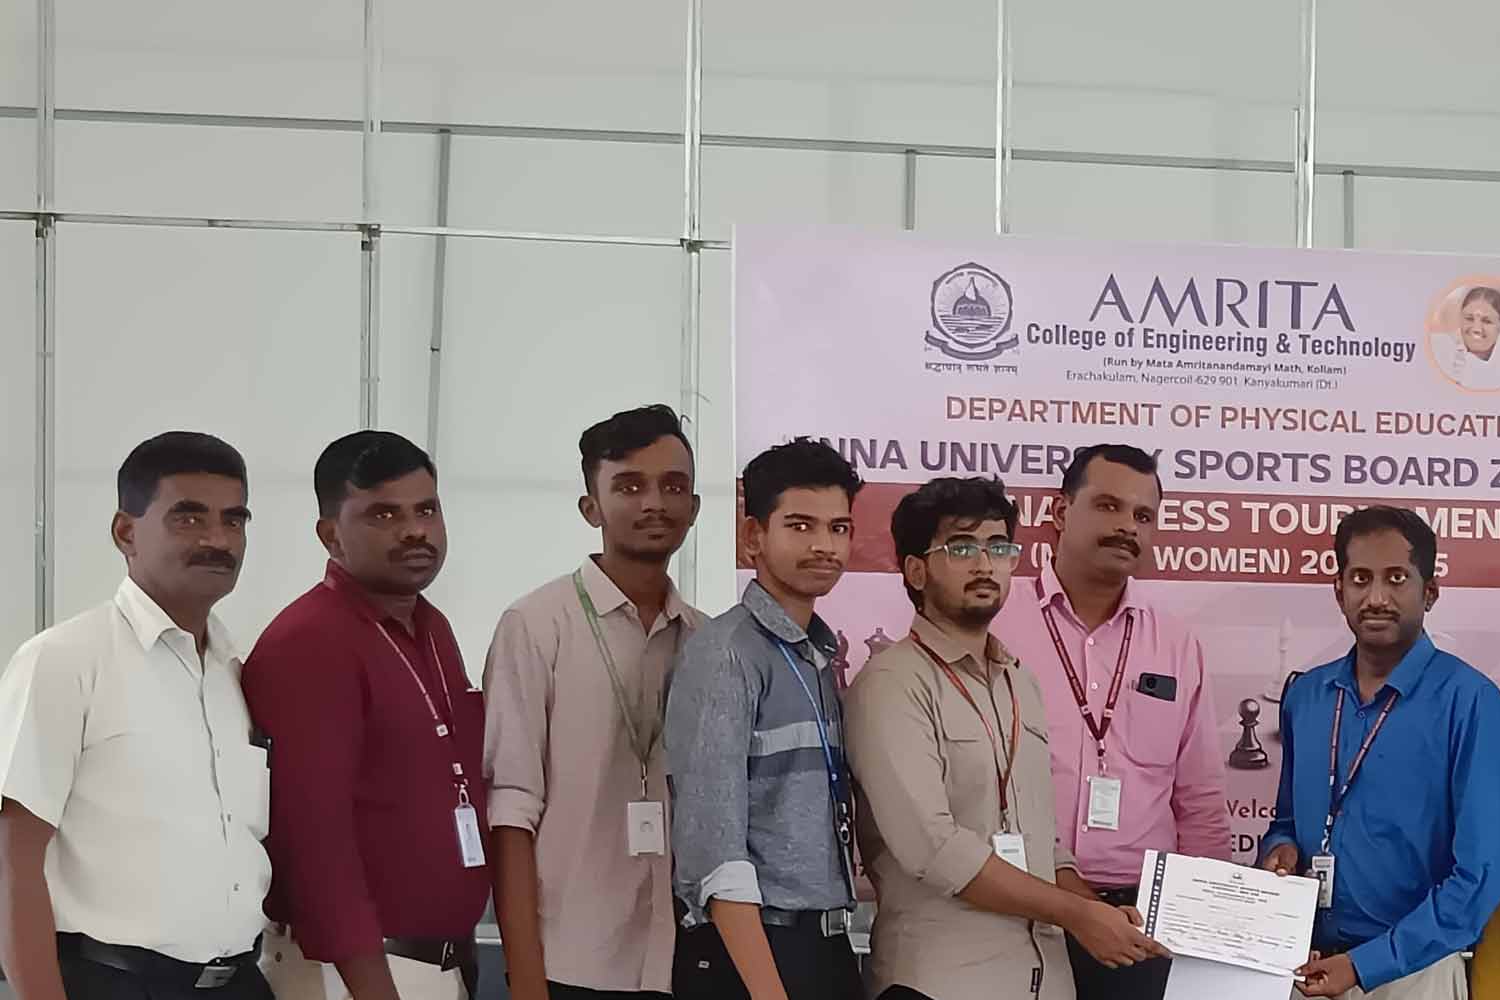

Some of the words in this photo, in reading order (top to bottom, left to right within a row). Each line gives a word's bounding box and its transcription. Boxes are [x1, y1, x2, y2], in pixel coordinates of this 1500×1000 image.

[1089, 273, 1356, 332] AMRITA
[1026, 323, 1106, 351] College
[1114, 328, 1135, 348] of
[1143, 328, 1268, 357] Engineering
[1276, 333, 1290, 354] &
[1299, 334, 1416, 363] Technology
[1130, 358, 1143, 370] by
[1146, 359, 1174, 369] Mata
[946, 396, 1162, 427] DEPARTMENT
[1170, 404, 1212, 429] OF
[1221, 406, 1367, 433] PHYSICAL
[1174, 449, 1332, 483] SPORTS
[1344, 455, 1480, 488] BOARD
[1152, 546, 1291, 575] WOMEN)
